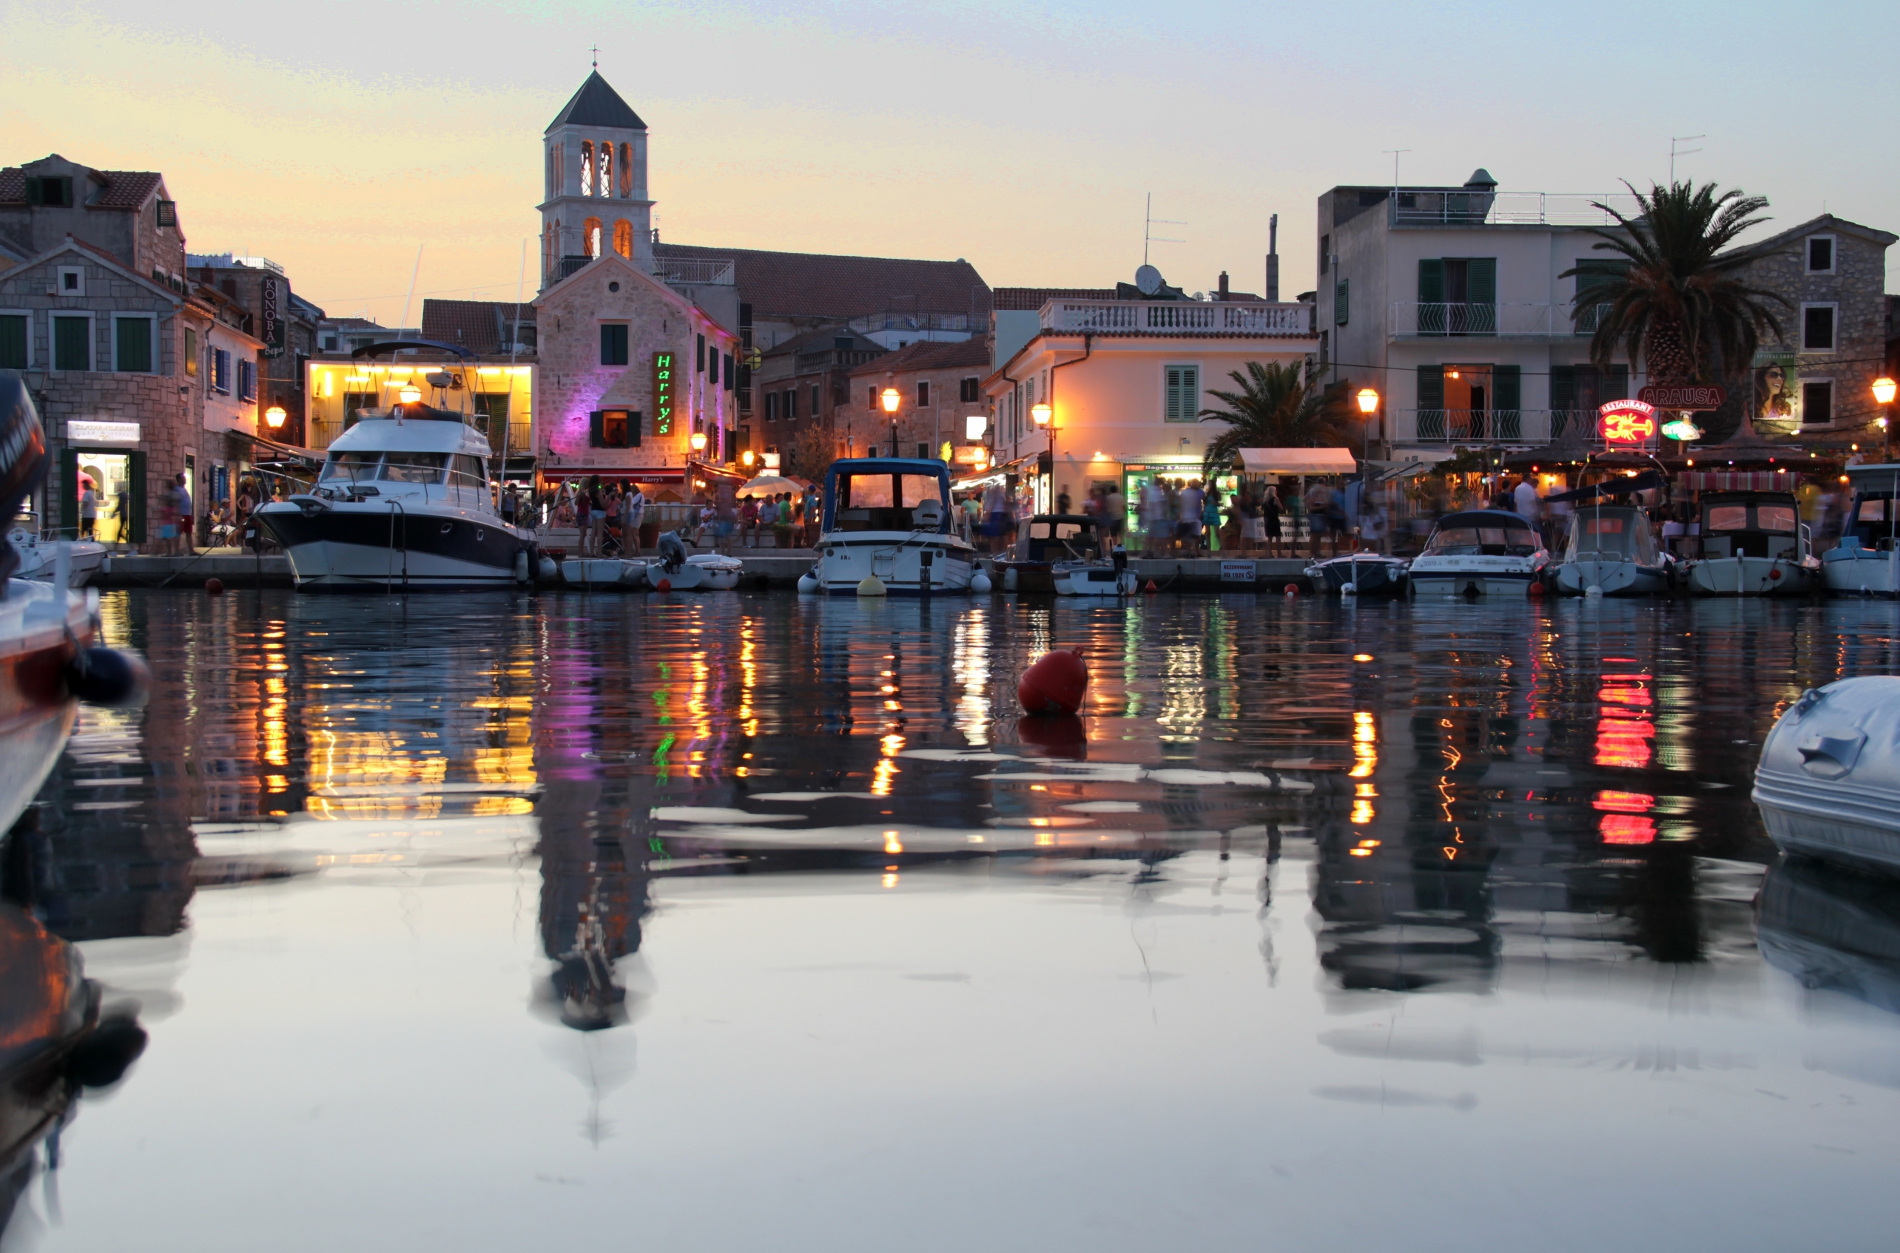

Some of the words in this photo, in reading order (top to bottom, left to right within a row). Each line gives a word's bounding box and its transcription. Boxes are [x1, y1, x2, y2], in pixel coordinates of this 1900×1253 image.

[264, 280, 276, 340] KONOBA
[657, 355, 671, 434] Harry's
[1642, 387, 1721, 405] ARAUSA
[1602, 400, 1652, 413] RESTAURANT
[641, 476, 664, 484] Harry's
